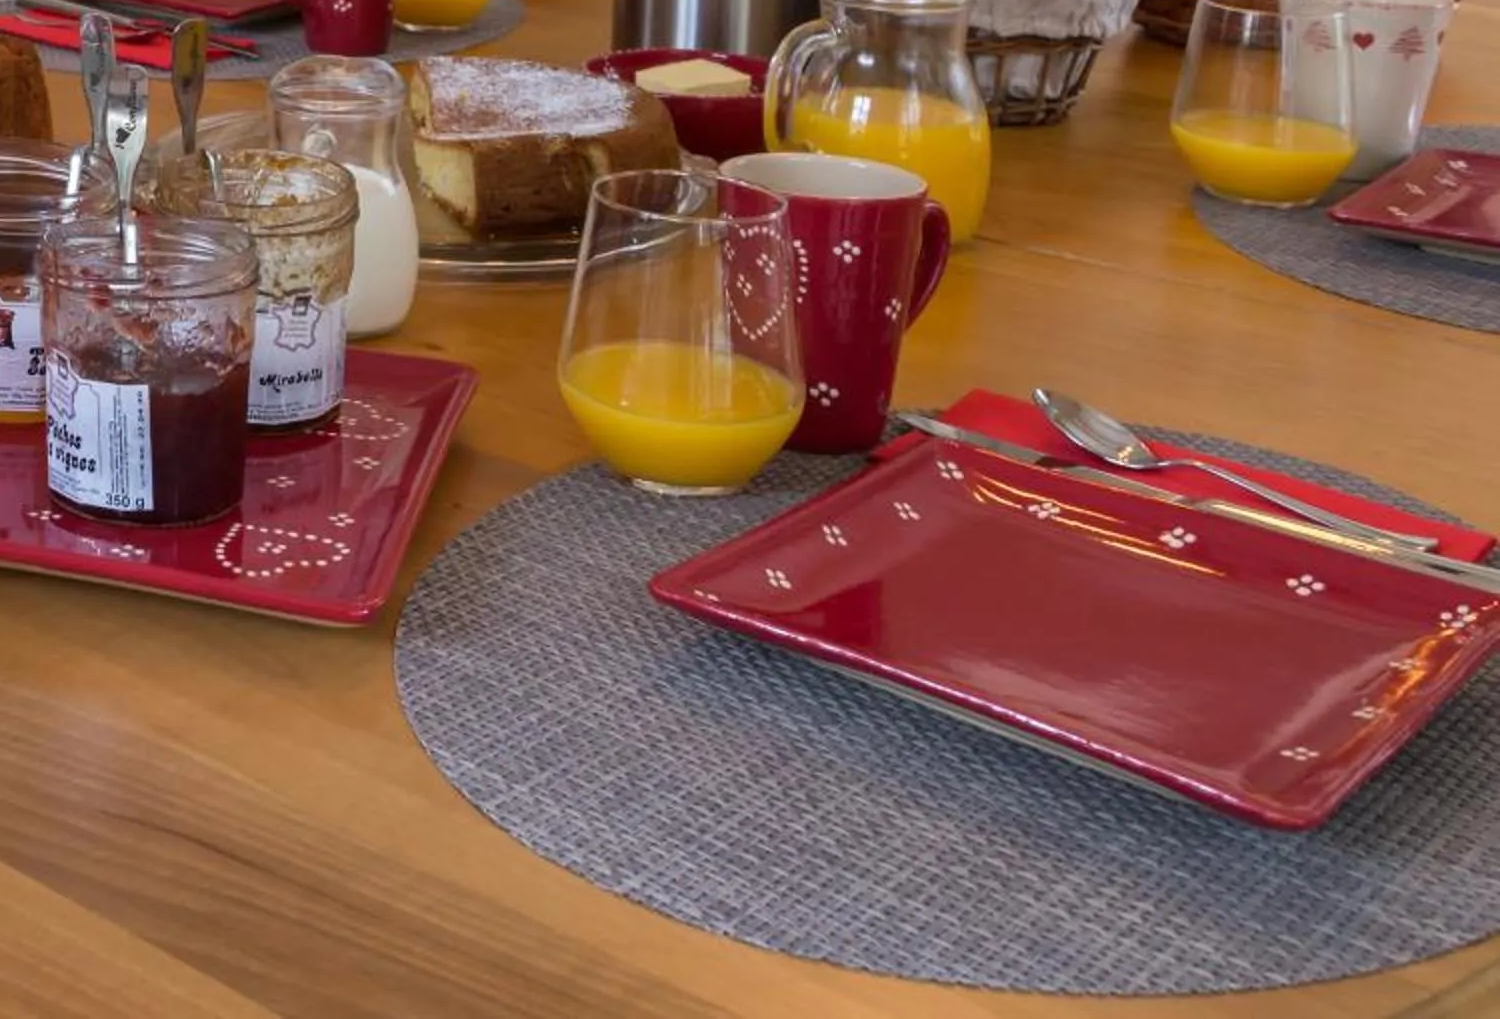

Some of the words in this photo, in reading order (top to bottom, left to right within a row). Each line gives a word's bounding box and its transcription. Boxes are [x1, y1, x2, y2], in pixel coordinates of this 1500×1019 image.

[55, 446, 97, 472] vignes
[105, 492, 131, 508] 350
[135, 496, 146, 510] g
